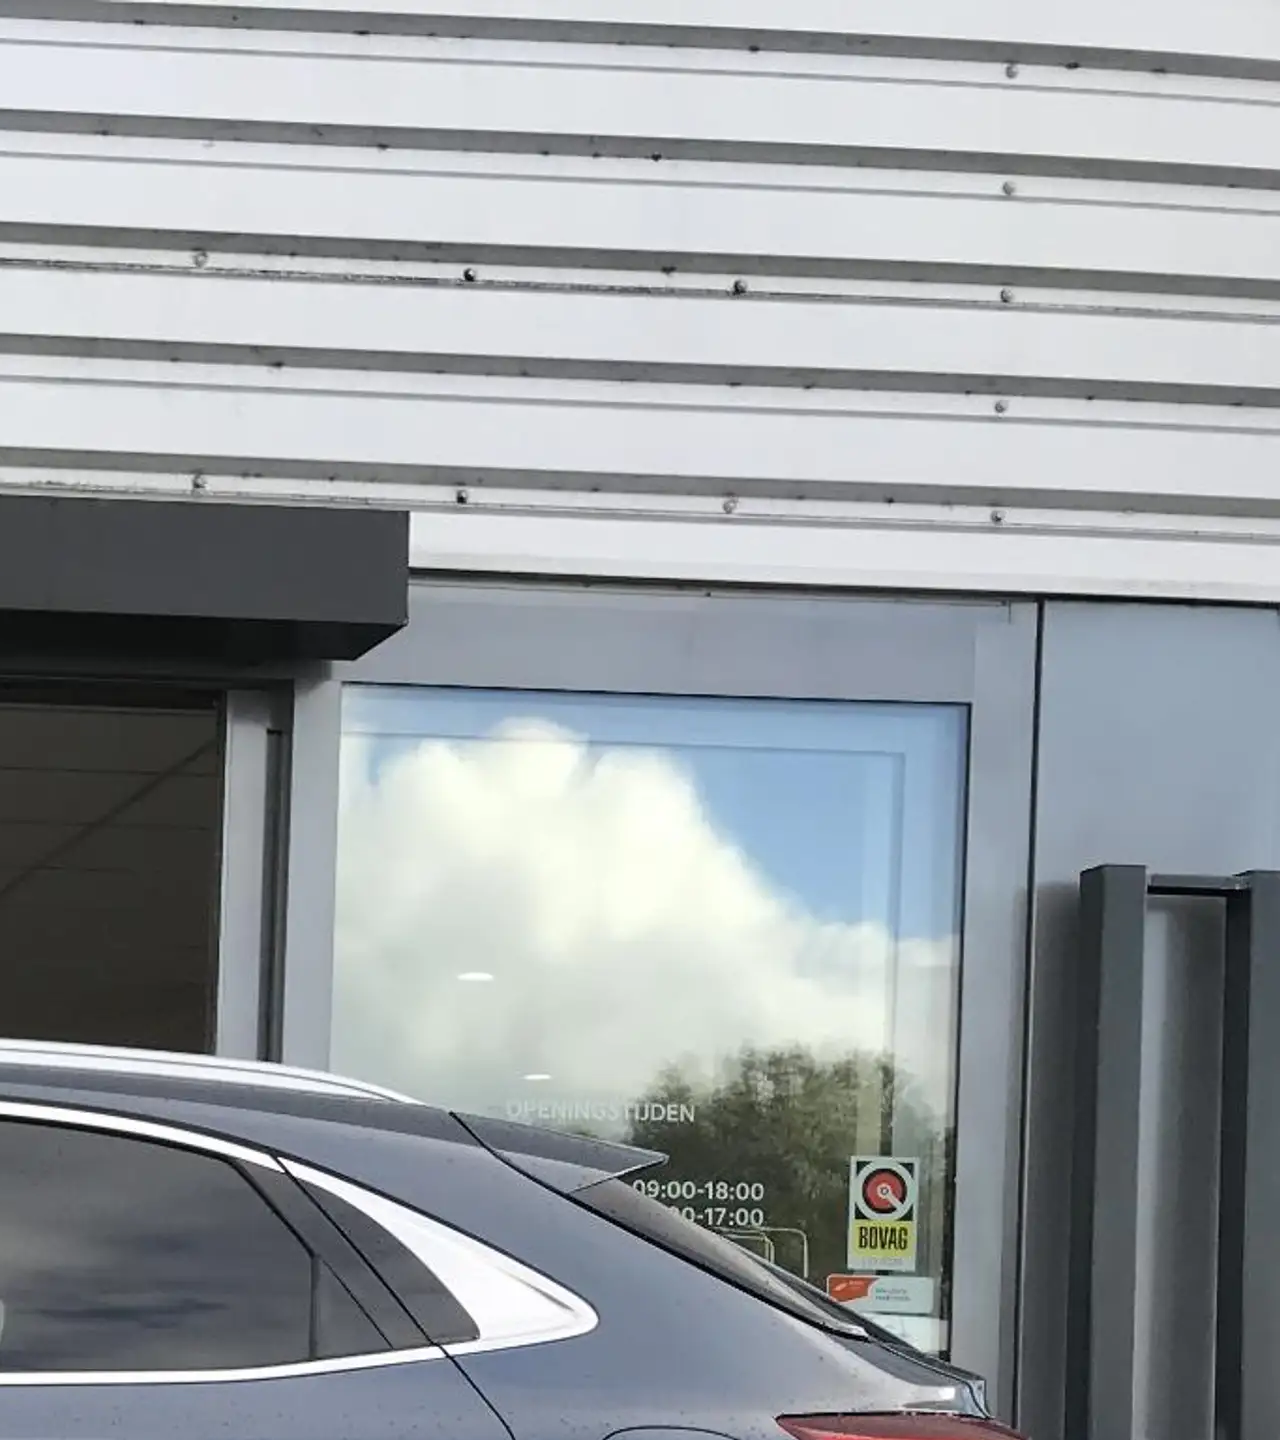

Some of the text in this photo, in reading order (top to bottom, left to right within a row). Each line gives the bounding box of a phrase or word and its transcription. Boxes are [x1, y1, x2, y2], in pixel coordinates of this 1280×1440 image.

[506, 1101, 695, 1123] OPENINGSTIJDEN
[632, 1179, 765, 1201] 09:00-18:00
[858, 1226, 909, 1251] BOVAG
